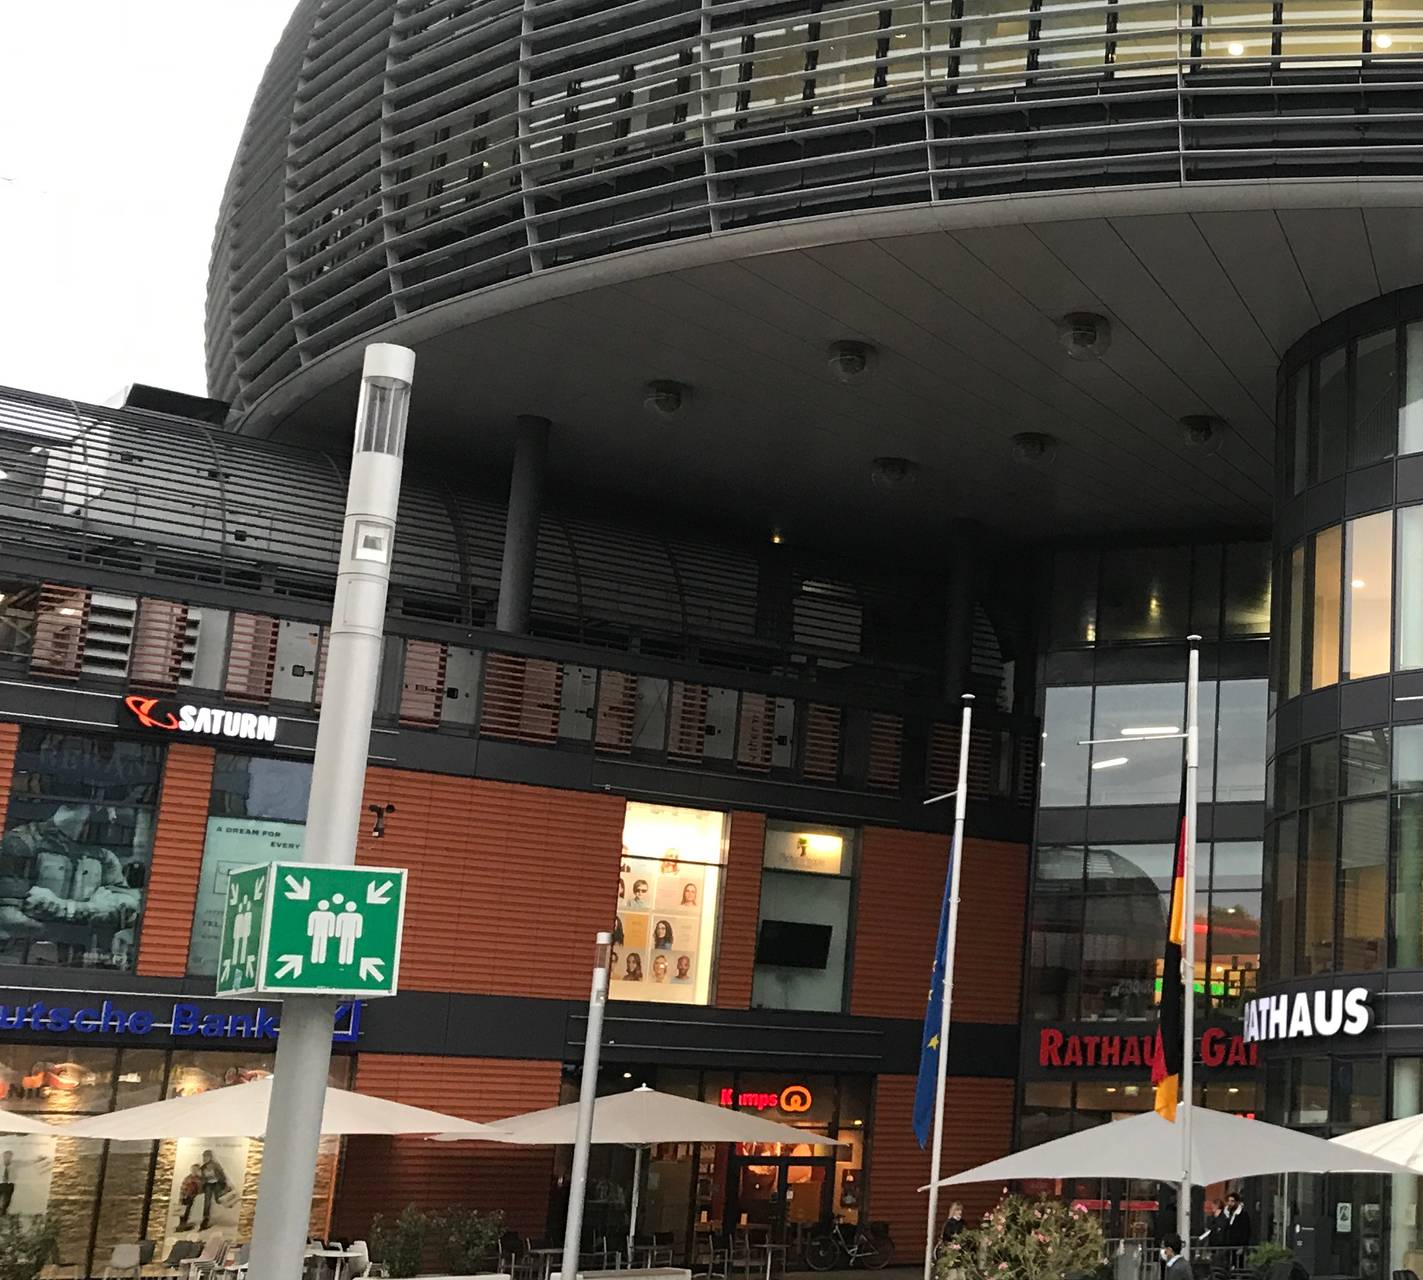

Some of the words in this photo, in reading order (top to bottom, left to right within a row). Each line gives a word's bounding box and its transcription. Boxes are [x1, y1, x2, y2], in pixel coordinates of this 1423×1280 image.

[178, 705, 277, 741] SATURN
[226, 827, 259, 836] DREAM
[262, 830, 282, 838] FOR
[0, 1000, 153, 1033] utsche
[171, 1003, 281, 1039] Bank
[1039, 1028, 1157, 1067] RATHAU
[1201, 1027, 1261, 1068] GA
[720, 1088, 778, 1110] Kmps
